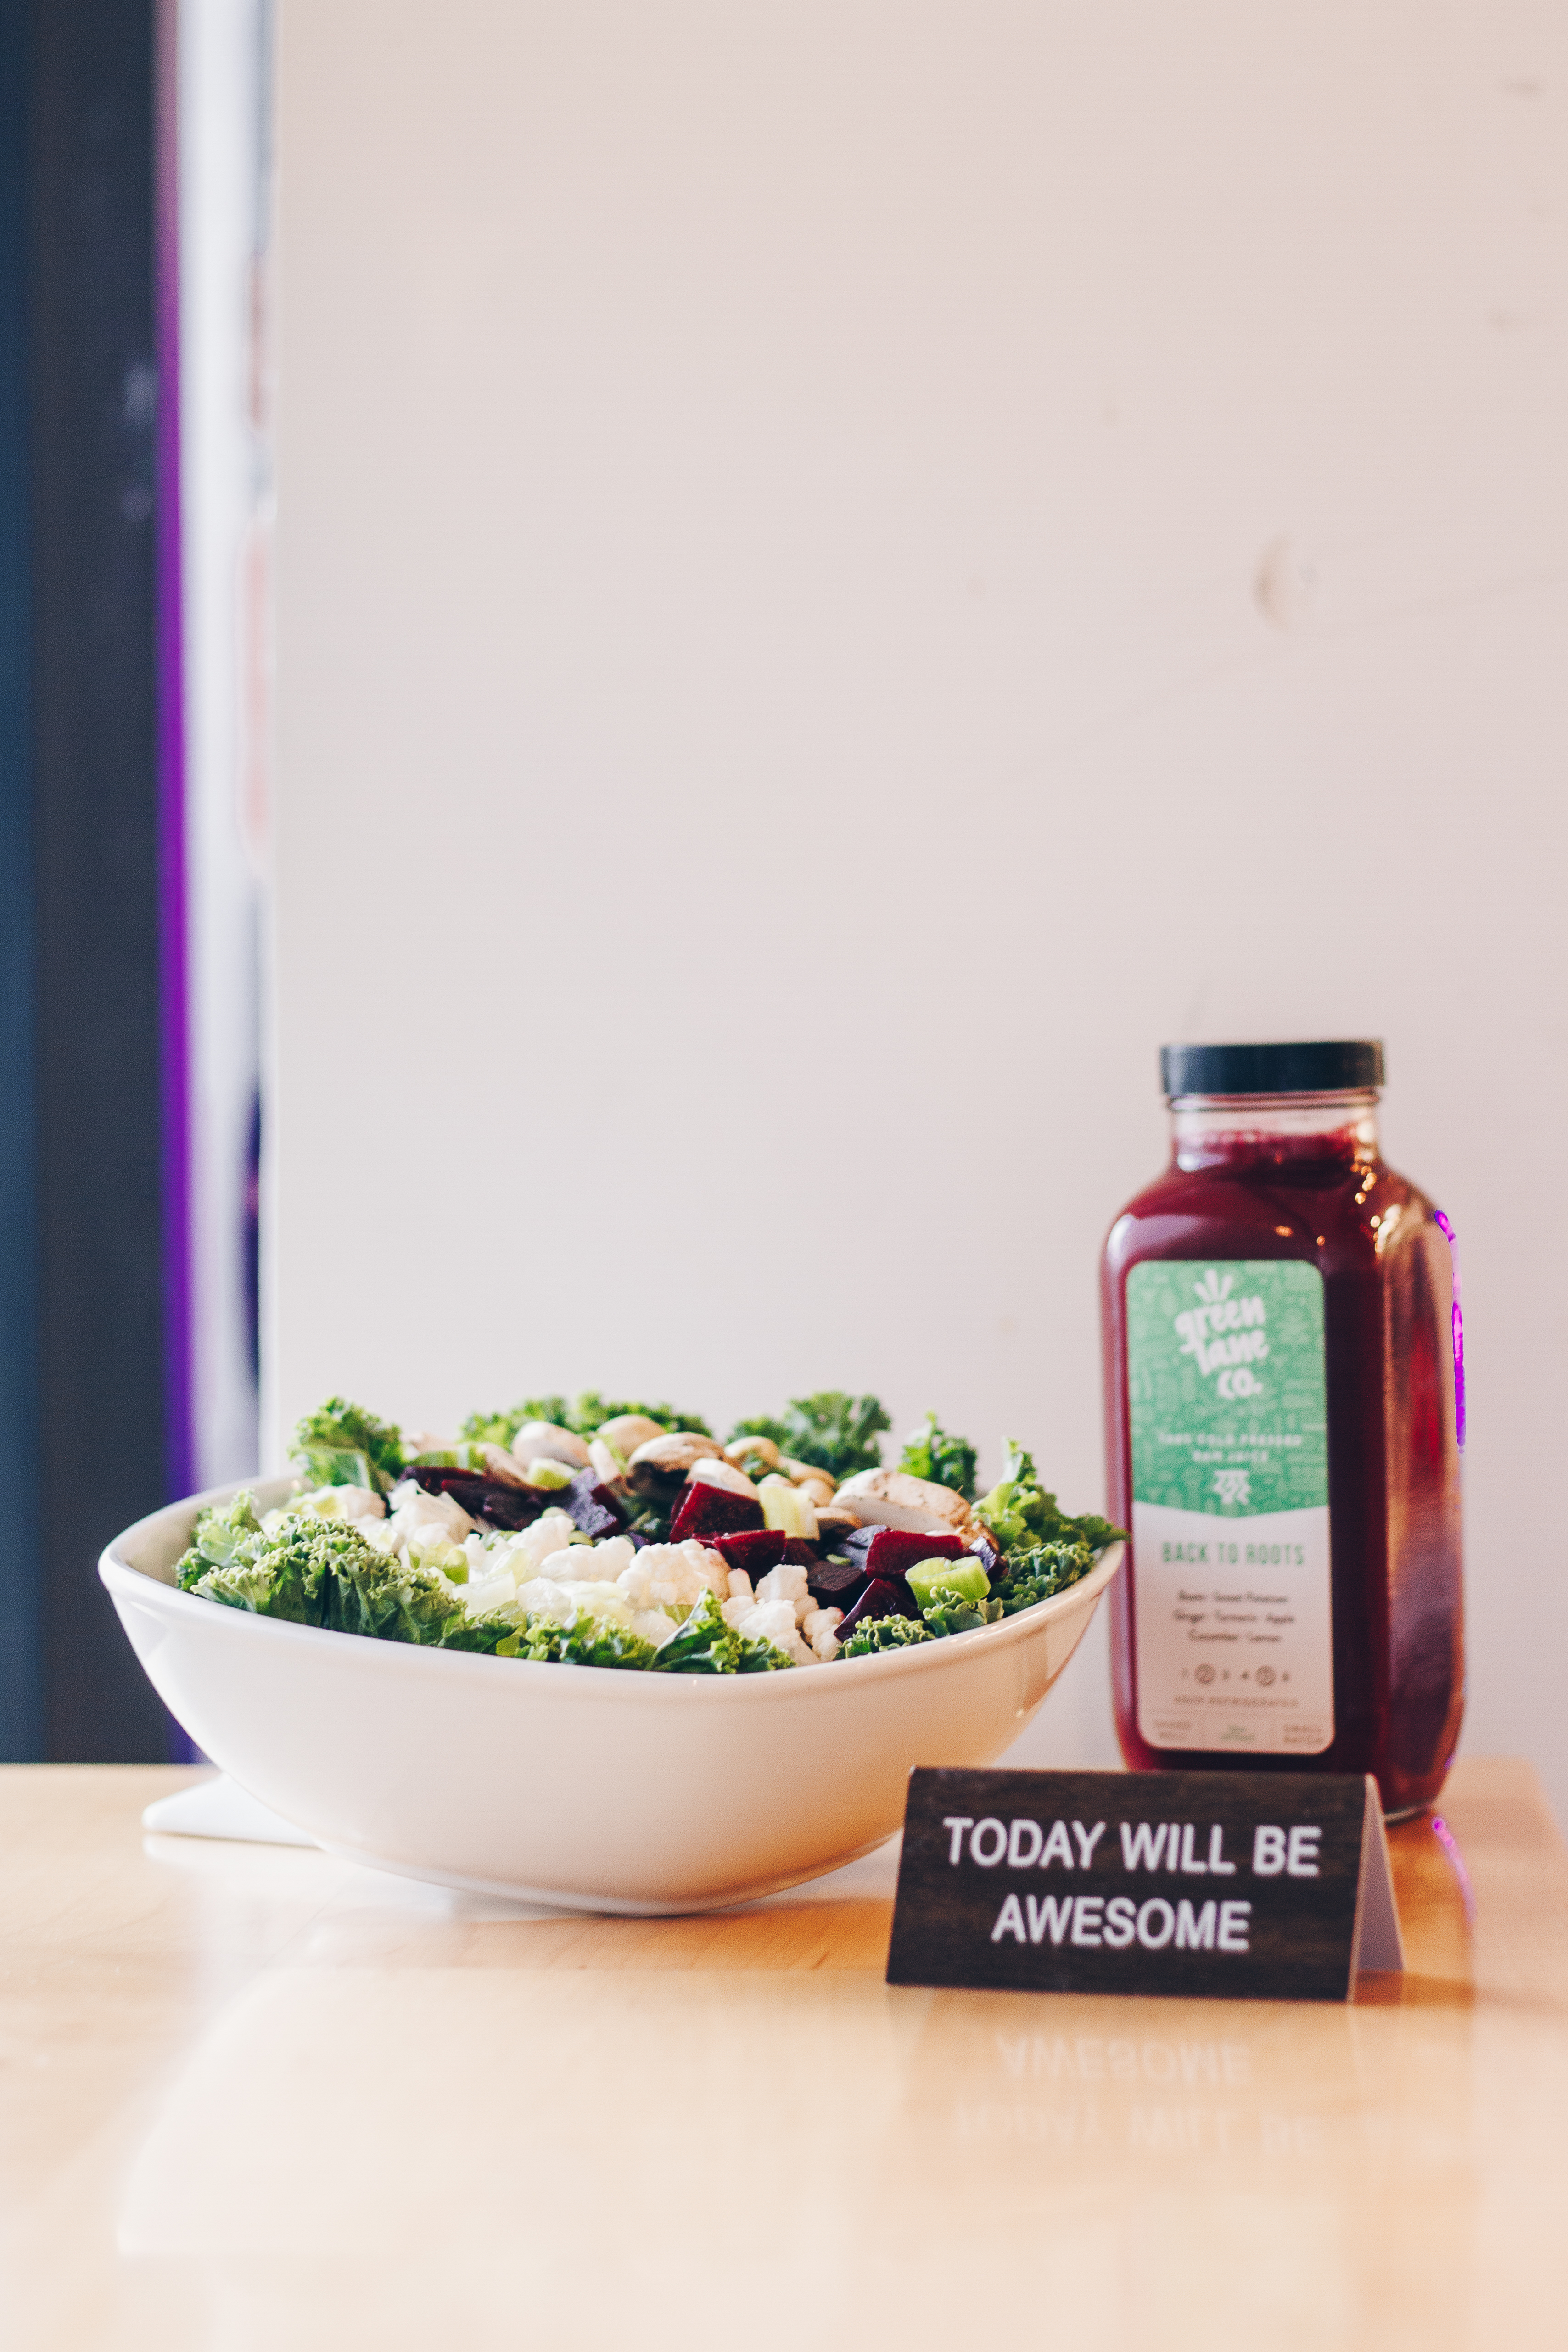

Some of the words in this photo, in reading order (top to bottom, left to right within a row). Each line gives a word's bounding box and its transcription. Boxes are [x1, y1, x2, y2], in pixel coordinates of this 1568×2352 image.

[1162, 1542, 1208, 1563] BACK
[1218, 1543, 1238, 1564] TO
[1246, 1543, 1305, 1566] ROOTS
[943, 1817, 1106, 1869] TODAY
[1120, 1822, 1236, 1874] WILL
[1253, 1826, 1322, 1876] BE
[991, 1894, 1251, 1952] AWESOME
